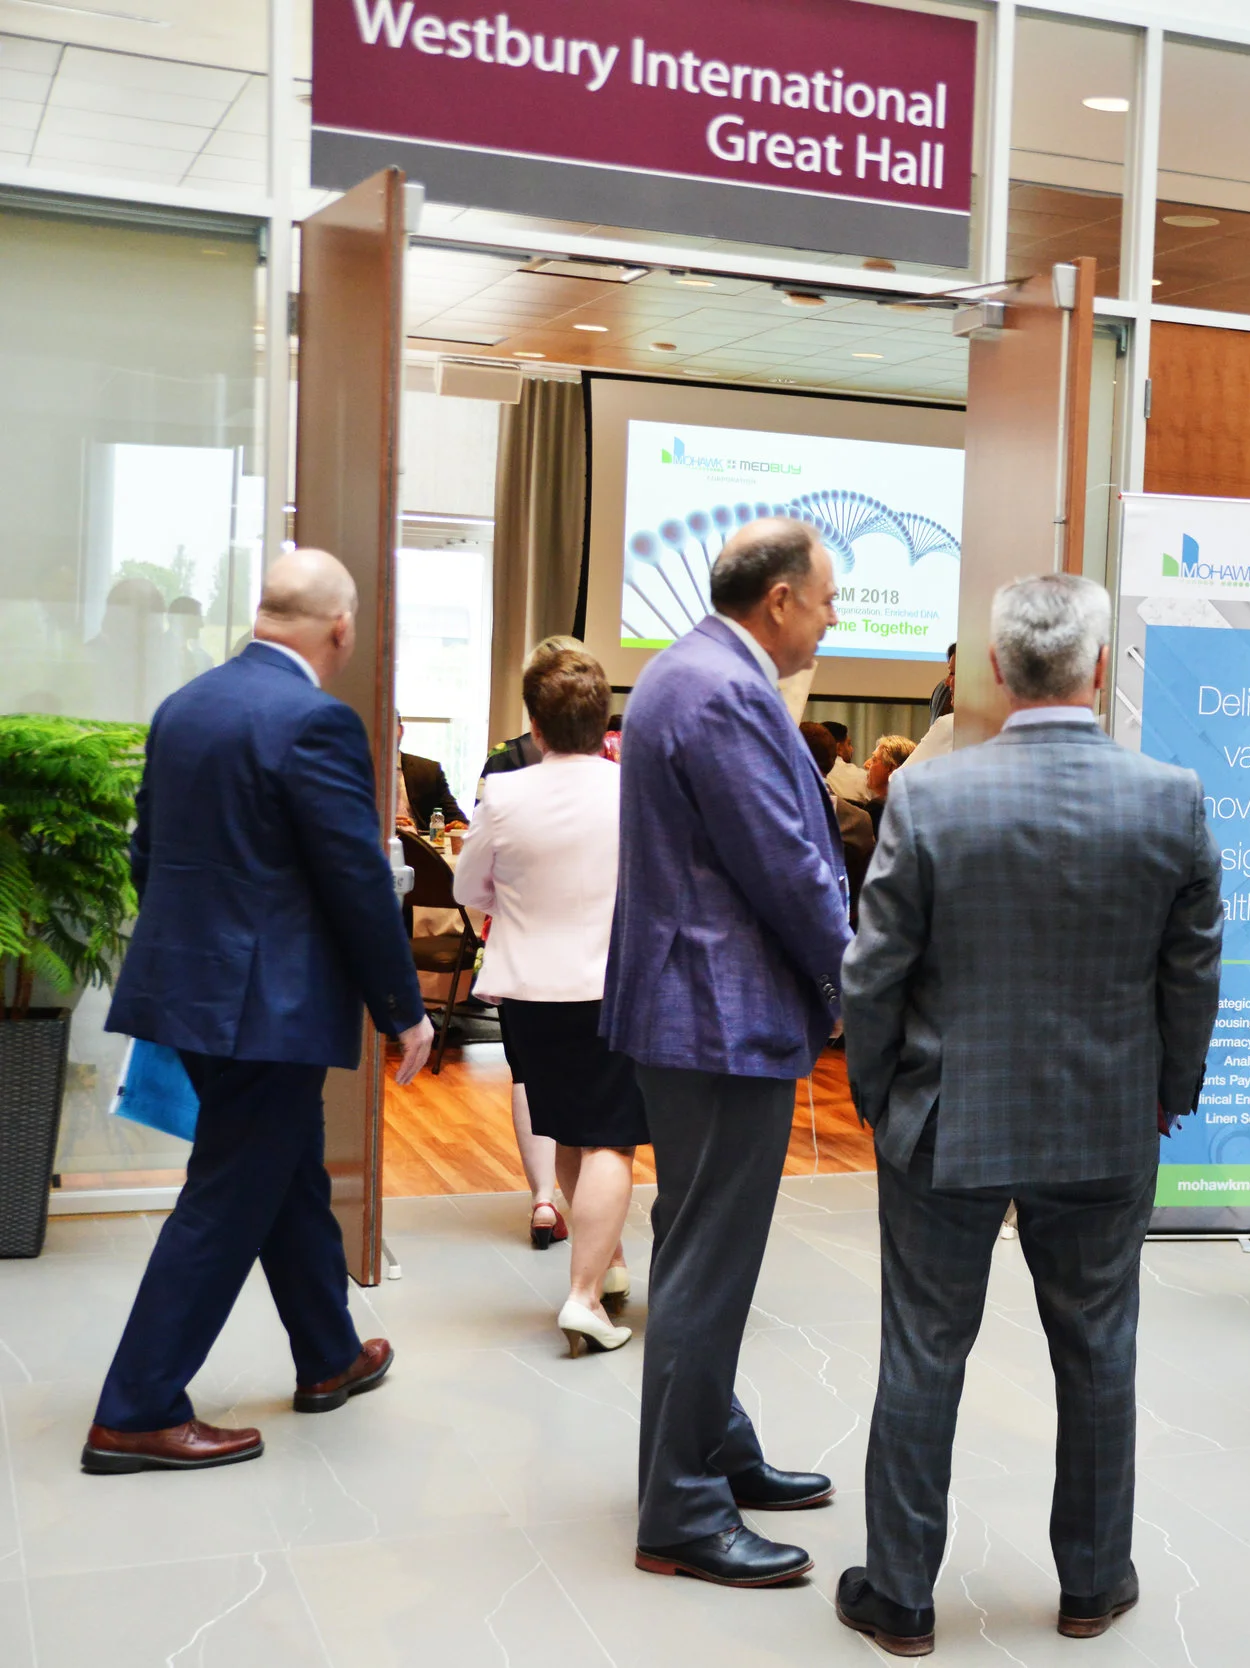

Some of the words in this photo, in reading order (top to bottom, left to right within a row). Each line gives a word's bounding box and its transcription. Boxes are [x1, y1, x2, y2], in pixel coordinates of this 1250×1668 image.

[354, 0, 620, 92] Westbury
[630, 36, 948, 129] International
[706, 113, 844, 176] Great
[856, 132, 945, 190] Hall
[673, 455, 723, 469] MOHAWK
[860, 588, 900, 605] 2018
[861, 618, 929, 637] Together
[1205, 1112, 1238, 1124] Linen
